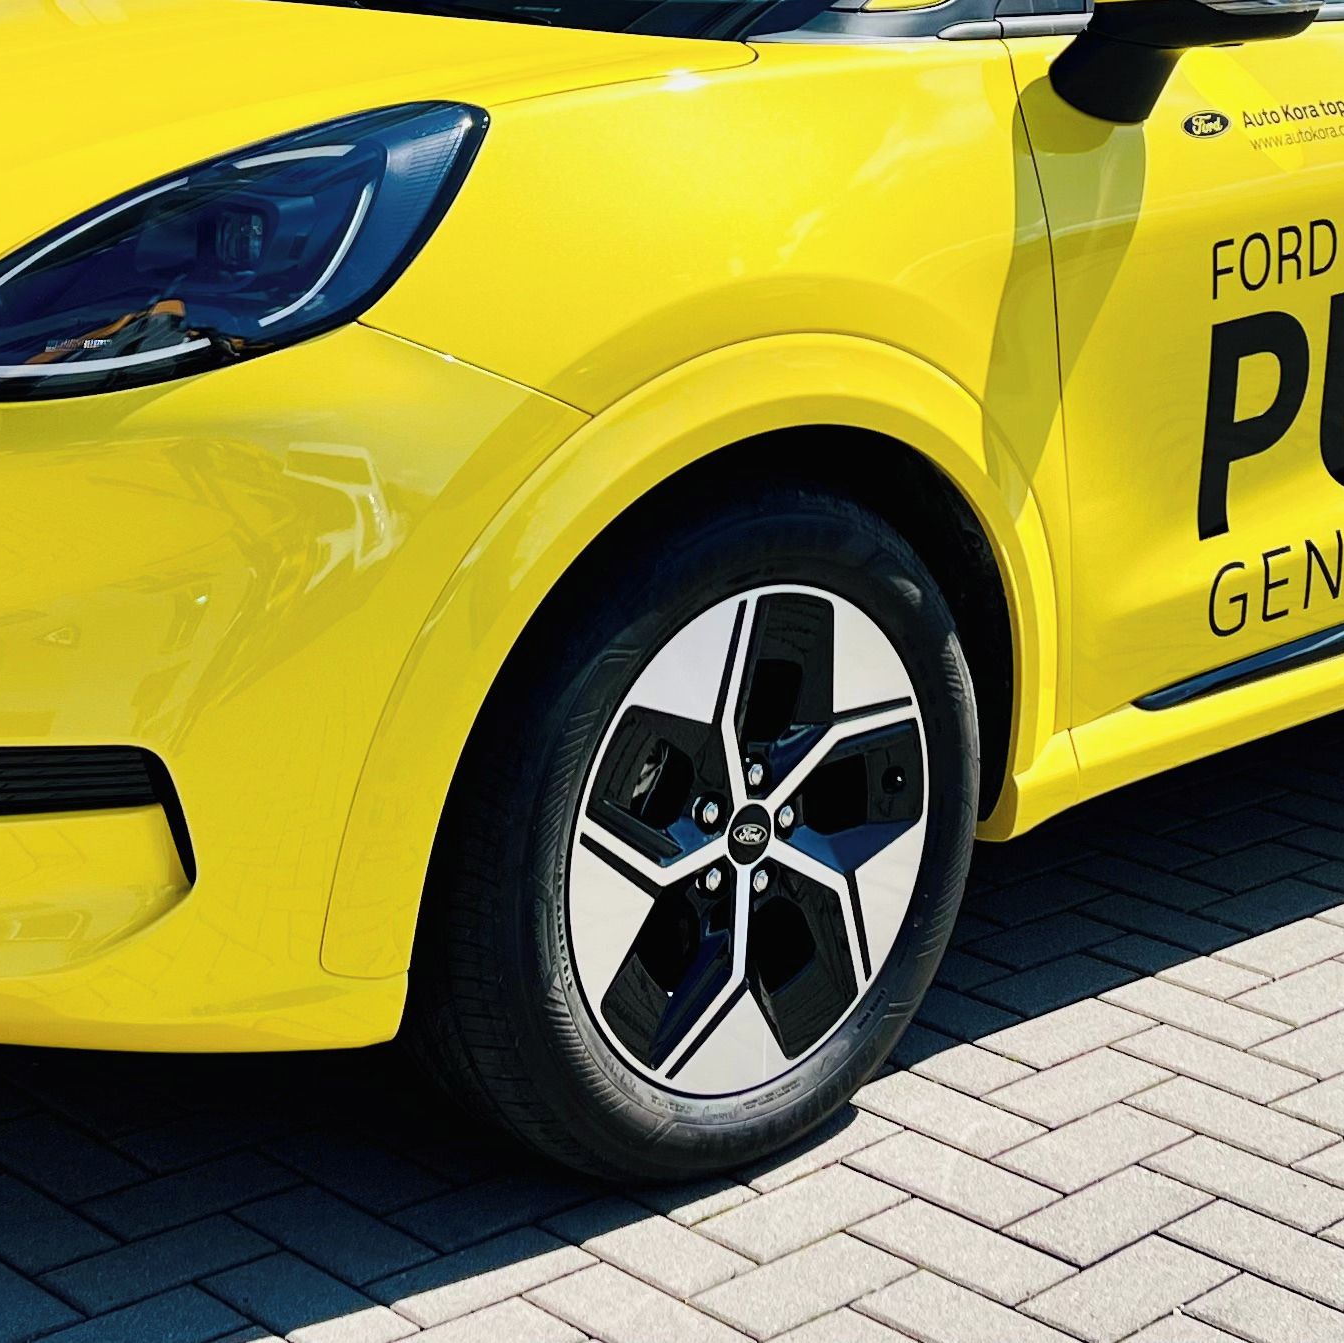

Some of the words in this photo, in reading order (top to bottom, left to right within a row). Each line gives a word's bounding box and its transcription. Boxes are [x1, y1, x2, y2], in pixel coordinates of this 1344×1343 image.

[1192, 114, 1223, 135] Ford
[1242, 110, 1280, 128] Auto
[1280, 104, 1319, 122] Kora
[1211, 218, 1339, 300] FORD
[739, 827, 763, 843] Ford
